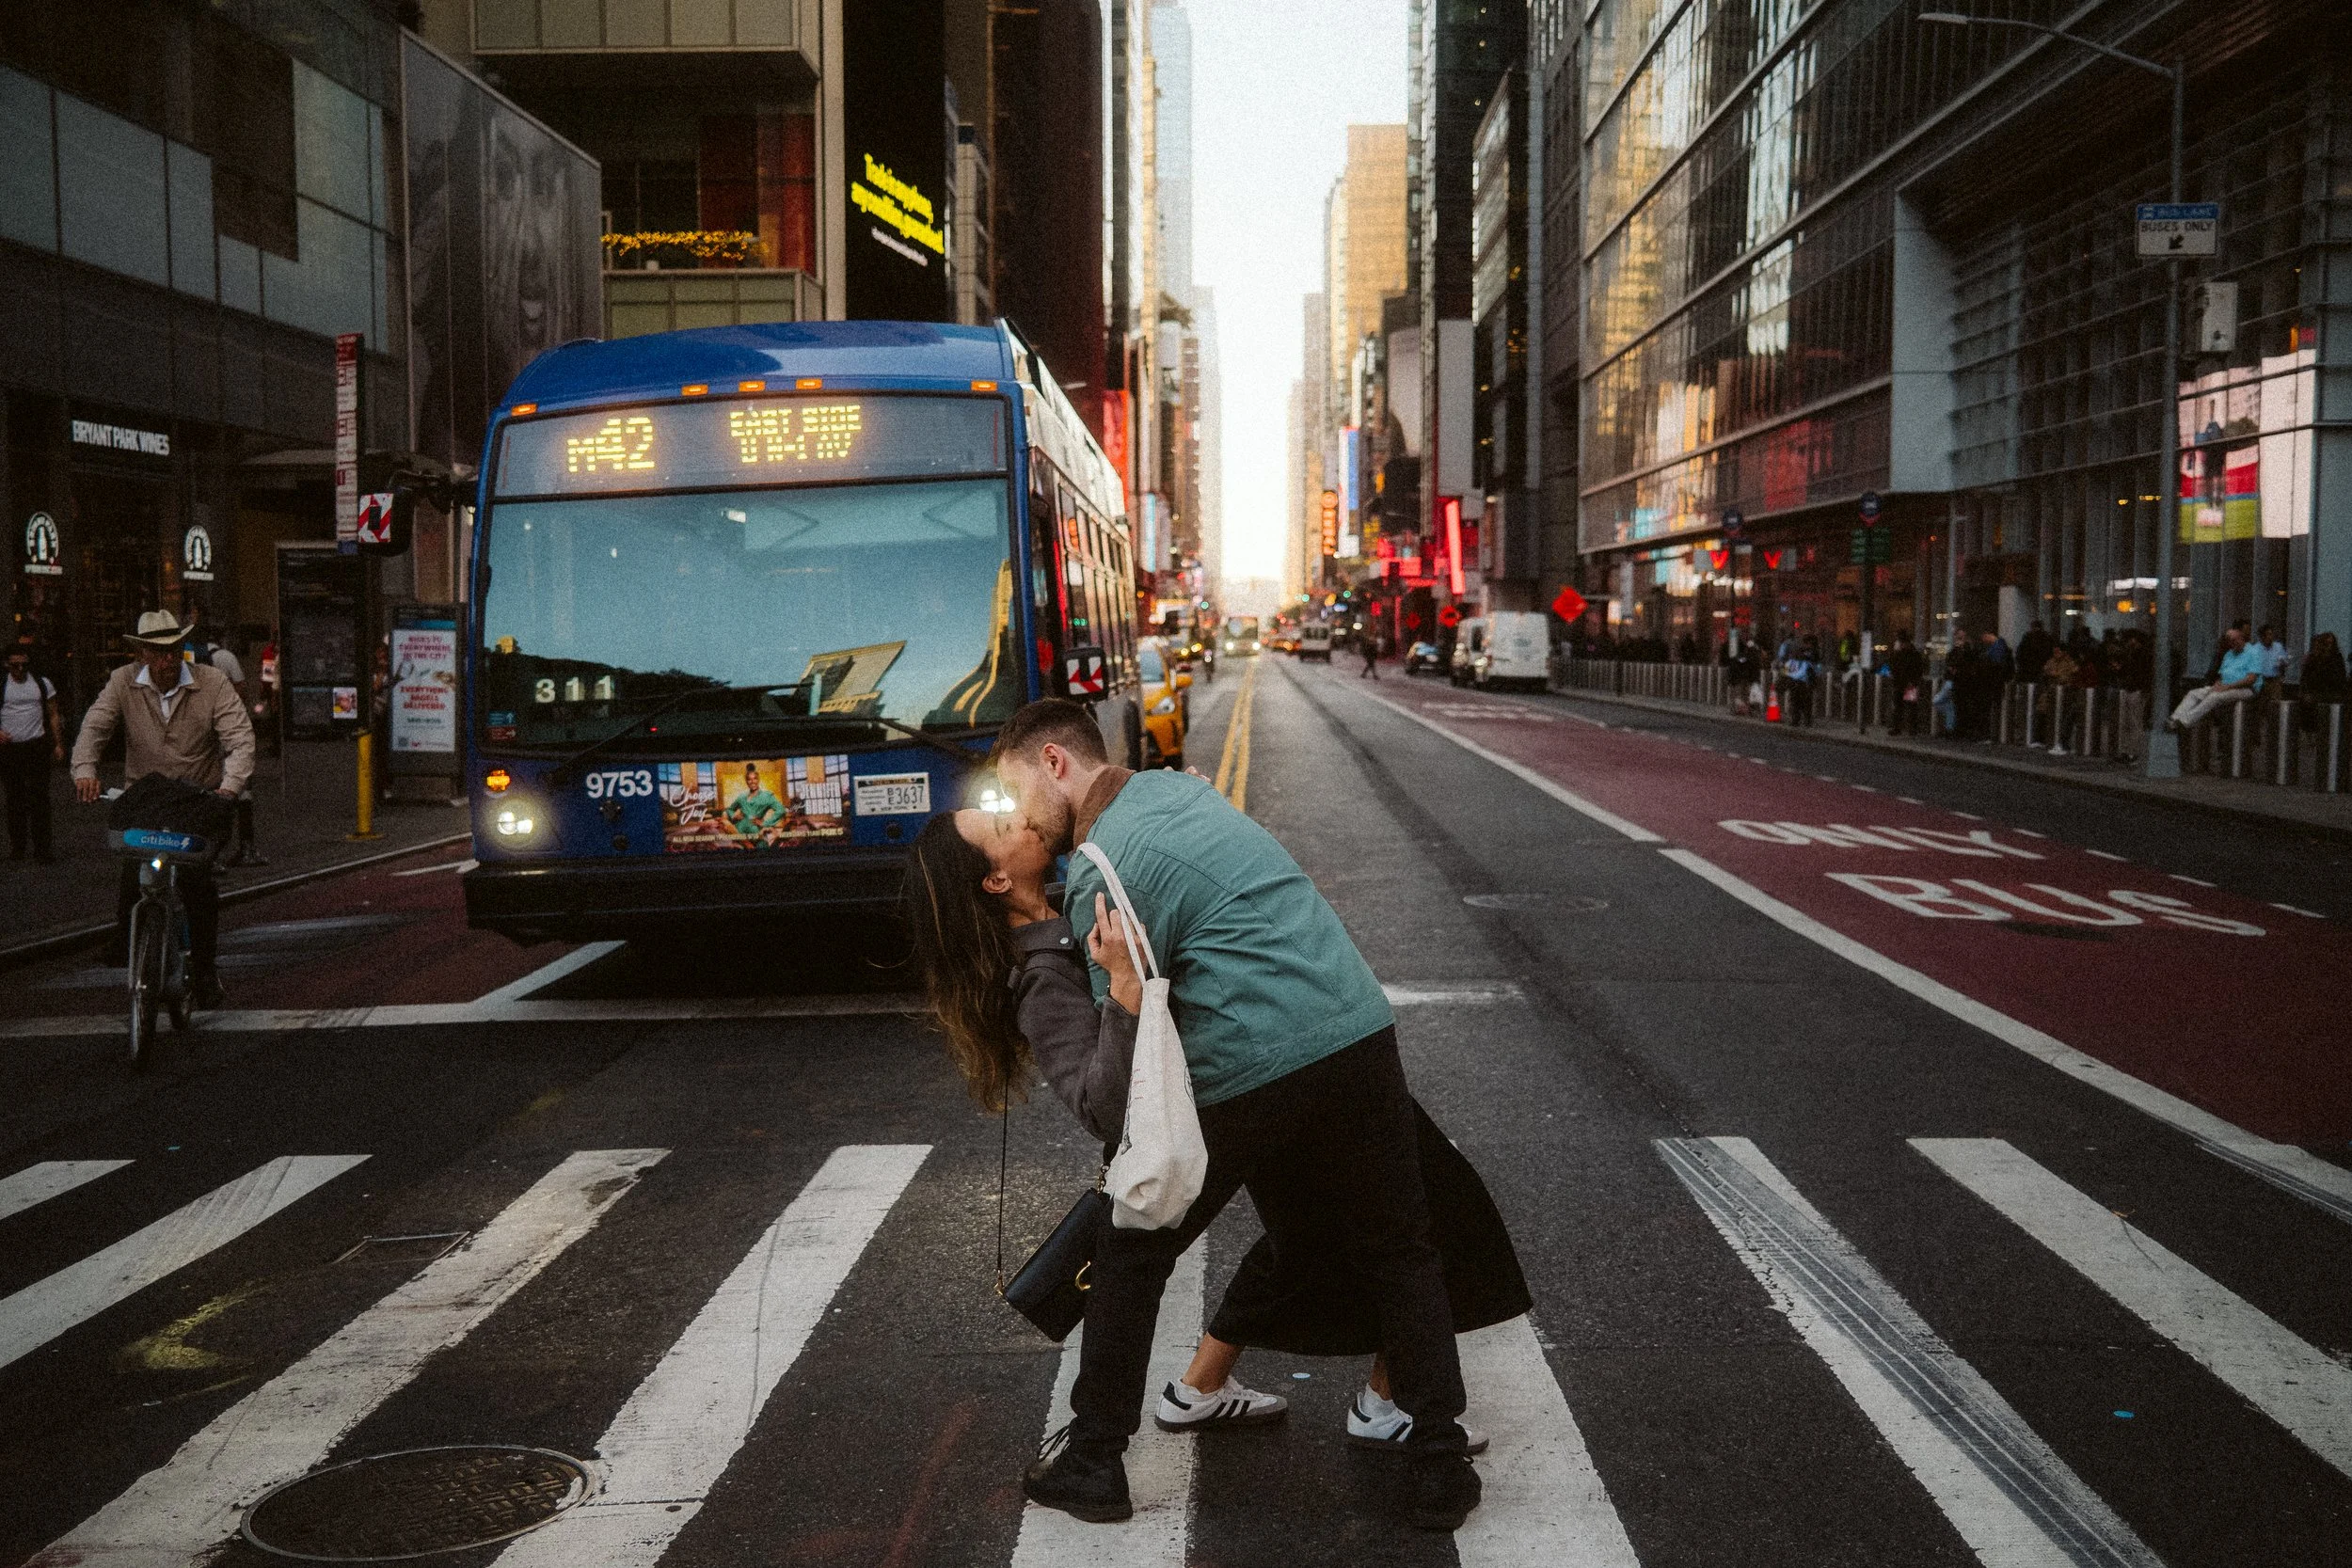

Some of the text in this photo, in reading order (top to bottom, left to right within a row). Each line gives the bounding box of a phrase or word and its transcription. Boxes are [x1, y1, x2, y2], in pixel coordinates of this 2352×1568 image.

[2141, 220, 2214, 232] BUSES ONLY
[72, 420, 170, 456] BRYANT PARK WINES
[566, 404, 862, 472] M42 EAST SIDE
[534, 674, 612, 704] 311
[585, 769, 654, 799] 9753
[669, 784, 716, 807] Choose
[896, 785, 924, 804] 3637
[679, 802, 708, 826] Joy
[1717, 819, 2047, 860] ONLY
[1823, 872, 2266, 936] BUS
